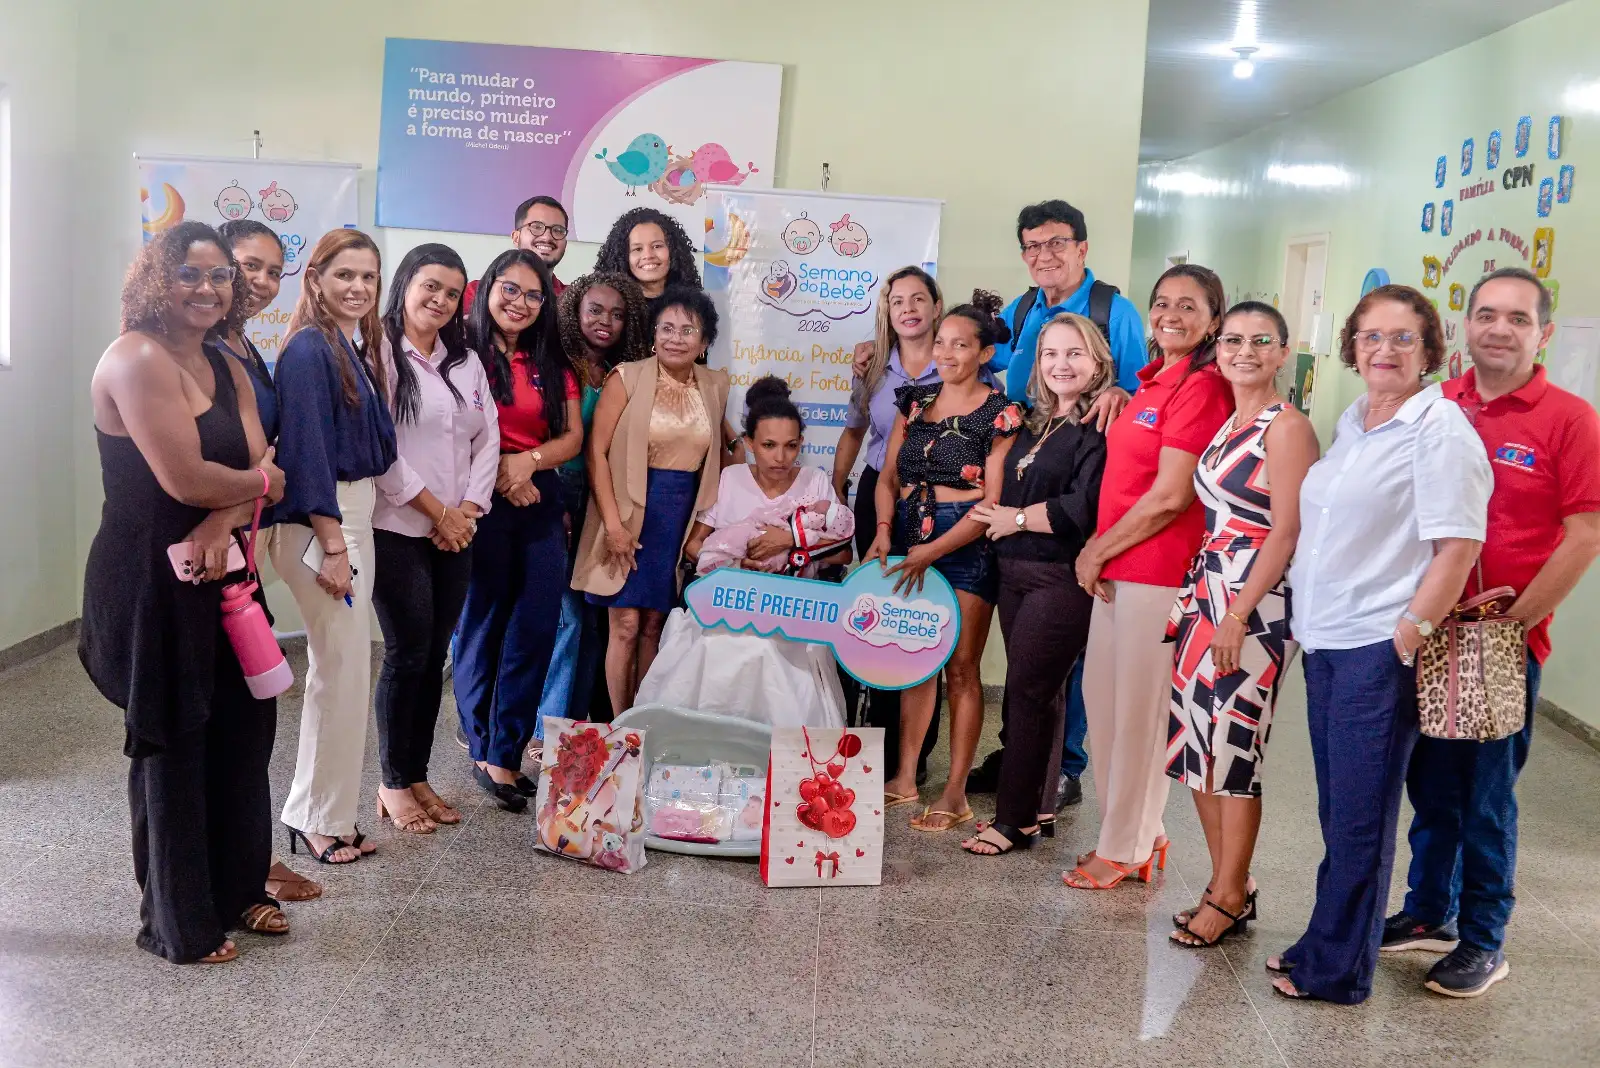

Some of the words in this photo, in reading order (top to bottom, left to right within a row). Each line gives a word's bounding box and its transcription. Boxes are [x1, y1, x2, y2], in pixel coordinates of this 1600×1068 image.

[461, 73, 519, 89] mudar
[523, 78, 535, 90] o
[408, 88, 474, 105] mundo,
[480, 91, 556, 108] primeiro
[407, 104, 418, 117] é
[422, 105, 485, 122] preciso
[490, 110, 549, 126] mudar
[406, 124, 417, 136] a
[421, 121, 472, 139] forma
[477, 125, 499, 141] de
[1502, 163, 1535, 190] CPN
[1442, 229, 1482, 277] MUDANDO
[1487, 227, 1495, 241] A
[1499, 227, 1530, 261] FORMA
[798, 263, 872, 282] Semana
[1483, 259, 1496, 273] DE
[799, 280, 818, 293] do
[819, 282, 866, 300] Bebê
[797, 320, 831, 332] 2026
[732, 340, 805, 364] Infância
[811, 344, 854, 365] Prote
[811, 408, 829, 420] de
[800, 442, 836, 455] rtura
[712, 586, 758, 612] BEBÊ
[760, 593, 839, 624] PREFEITO
[881, 602, 939, 623] Semana
[881, 617, 897, 628] do
[898, 619, 937, 638] Bebê
